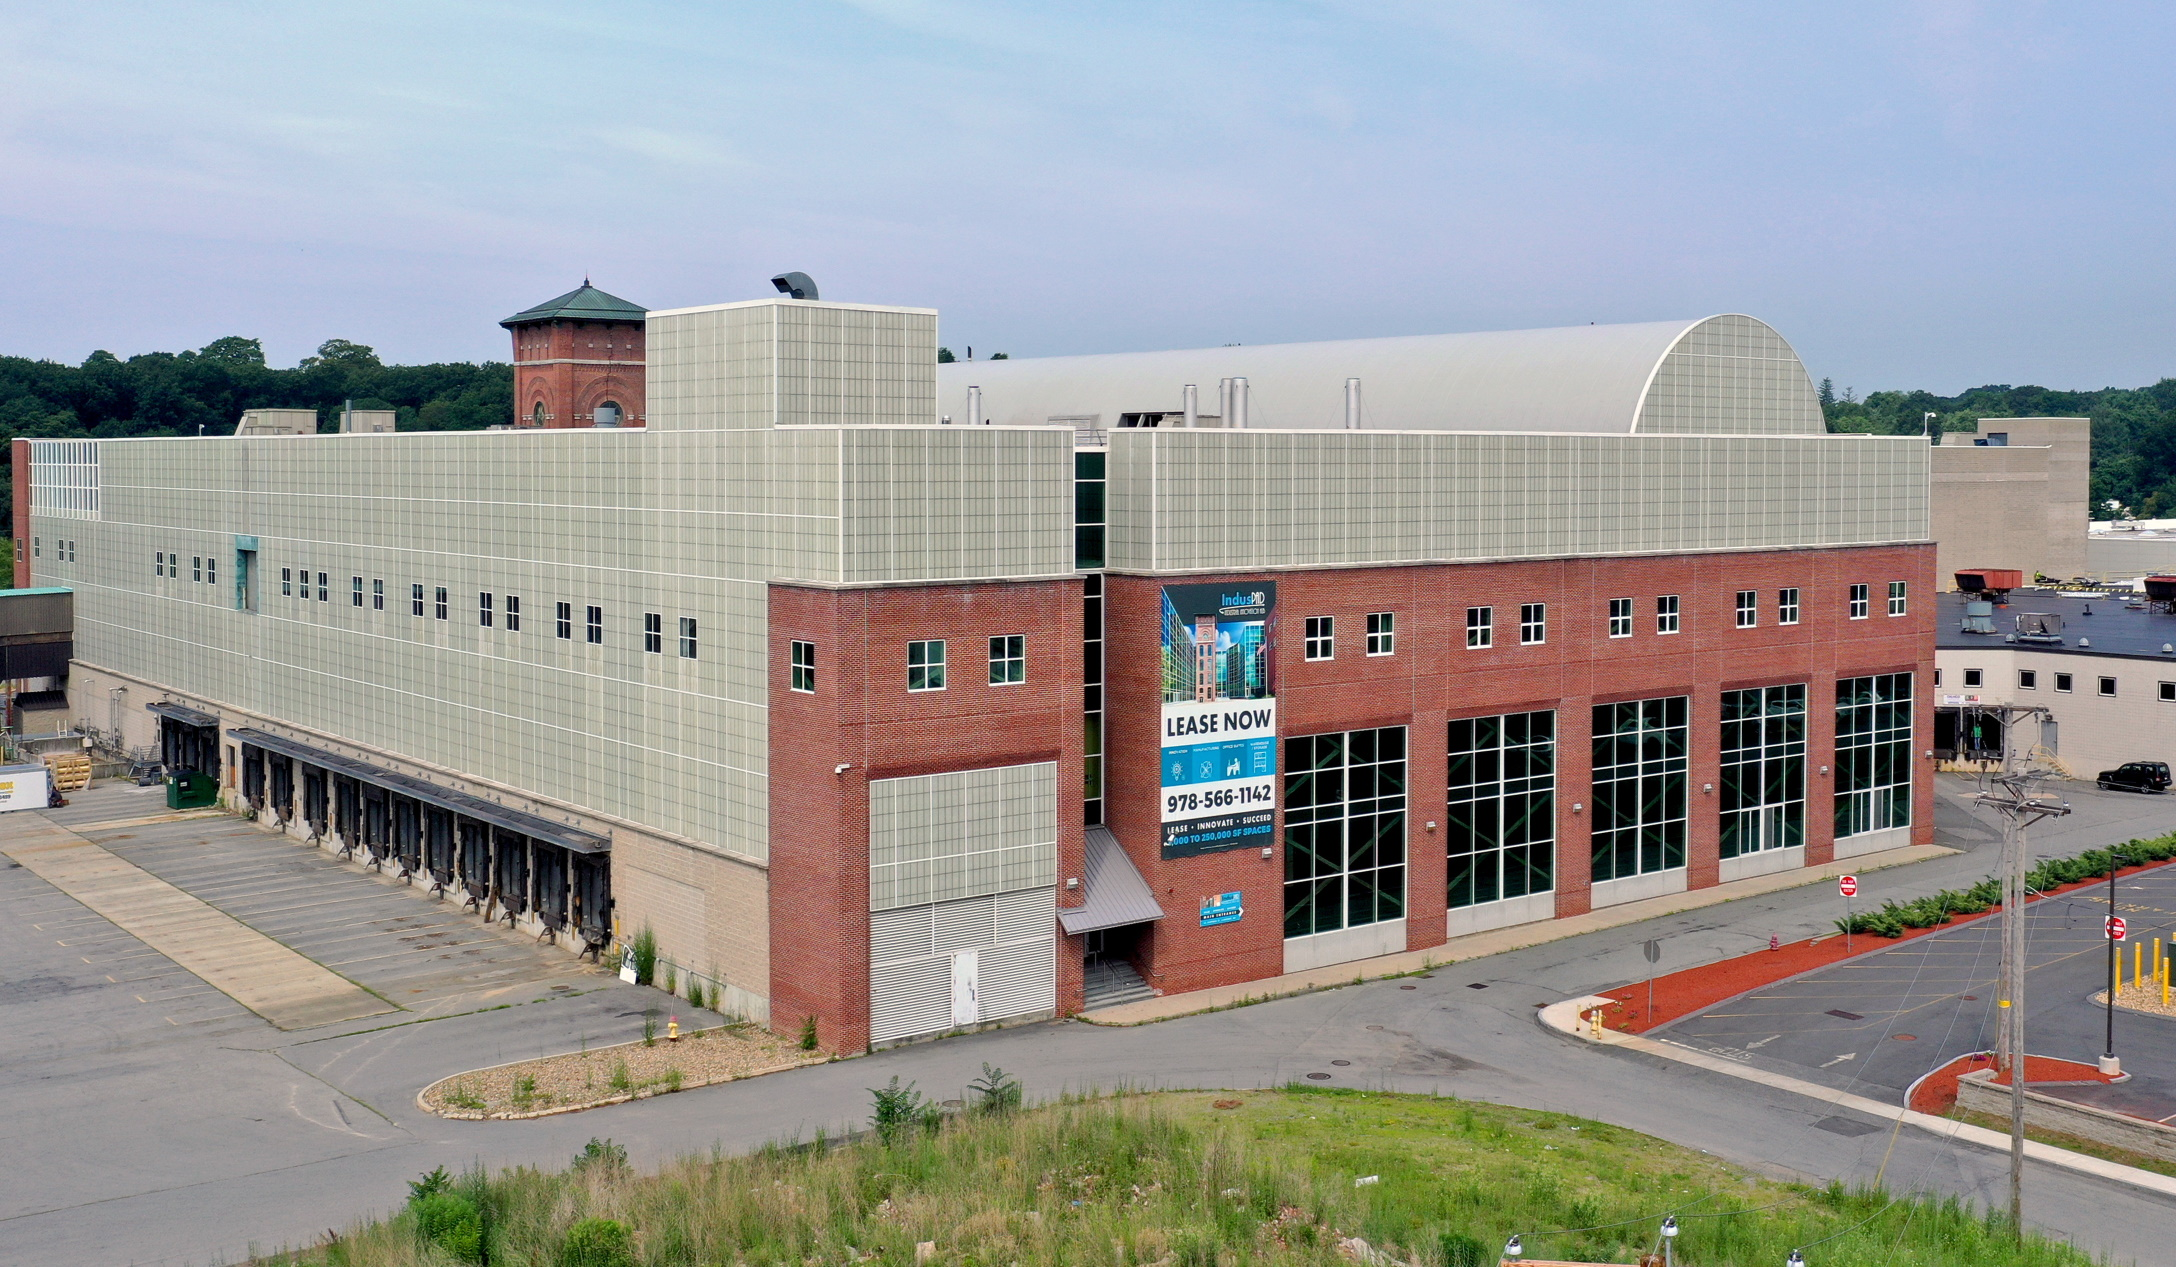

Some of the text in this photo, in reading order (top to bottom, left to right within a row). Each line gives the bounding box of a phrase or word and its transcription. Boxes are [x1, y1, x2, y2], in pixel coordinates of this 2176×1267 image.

[1221, 591, 1265, 606] IndusPAD
[1167, 709, 1271, 737] LEASE NOW
[1168, 784, 1271, 813] 978-566-1142
[1167, 814, 1271, 835] LEASE INNOVATE SUCCEED
[1168, 836, 1190, 846] ,000
[1190, 835, 1200, 843] TO
[1201, 831, 1231, 841] 250,000
[1232, 829, 1242, 837] SF
[1243, 825, 1271, 836] SPACES
